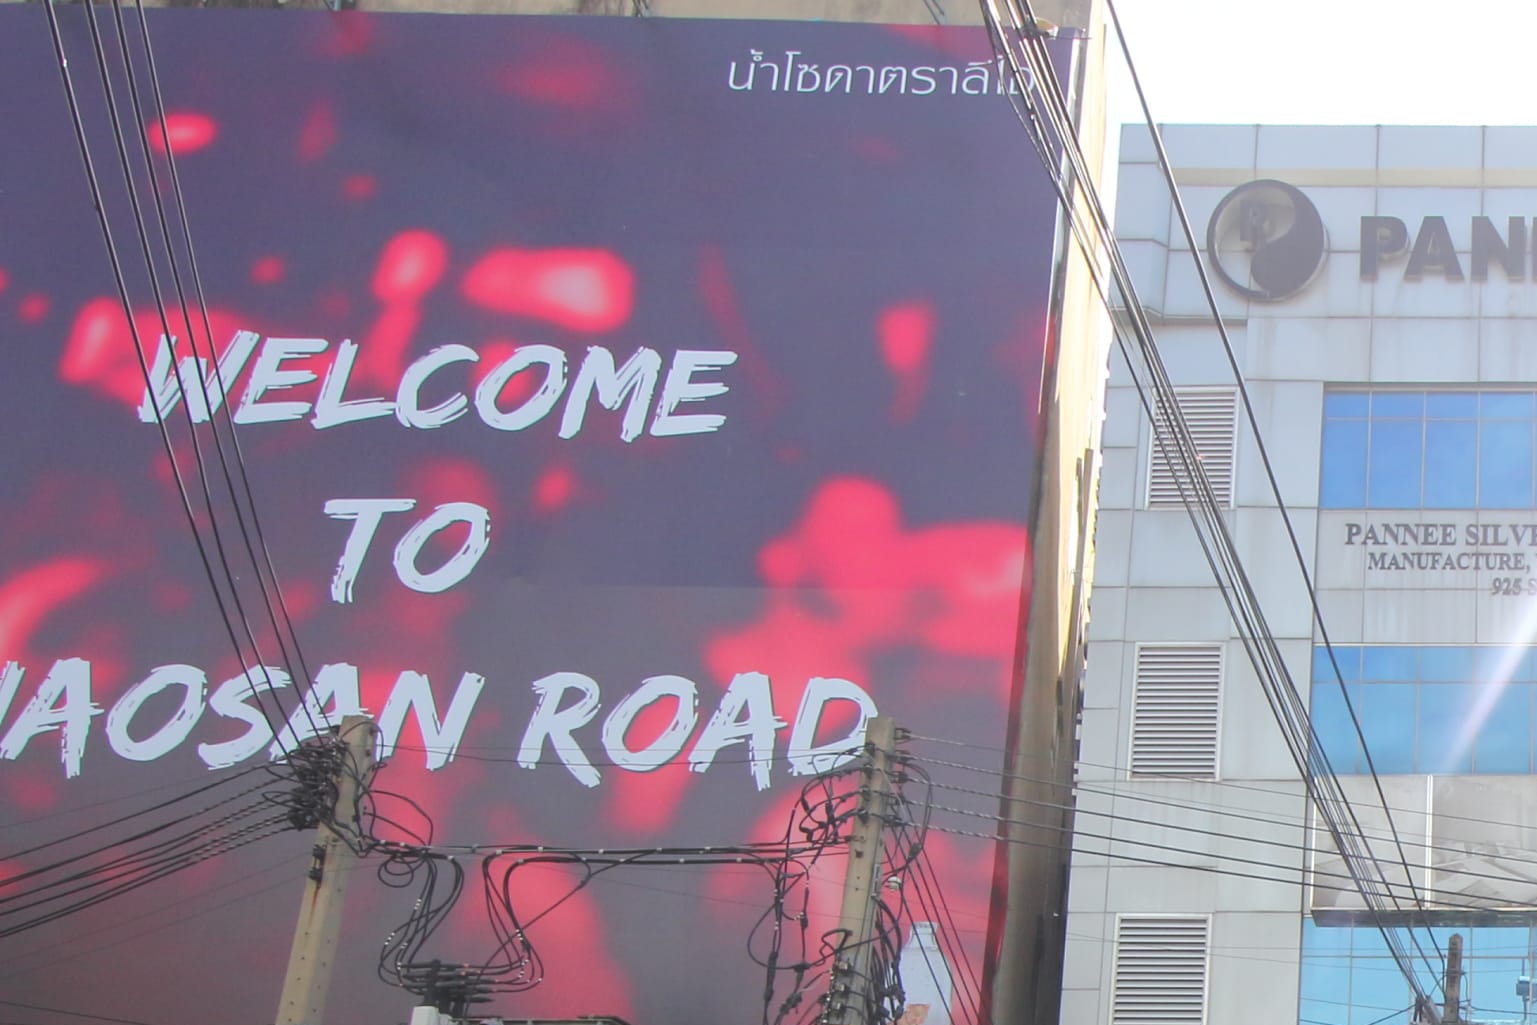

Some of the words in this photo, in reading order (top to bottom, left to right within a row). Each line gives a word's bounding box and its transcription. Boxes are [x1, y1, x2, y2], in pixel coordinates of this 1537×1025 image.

[138, 329, 739, 443] WELCOME
[322, 497, 492, 603] TO
[1344, 522, 1458, 546] PANNEE
[1367, 552, 1530, 573] MANUFACTURE,
[1491, 577, 1523, 596] 925
[517, 670, 880, 789] ROAD
